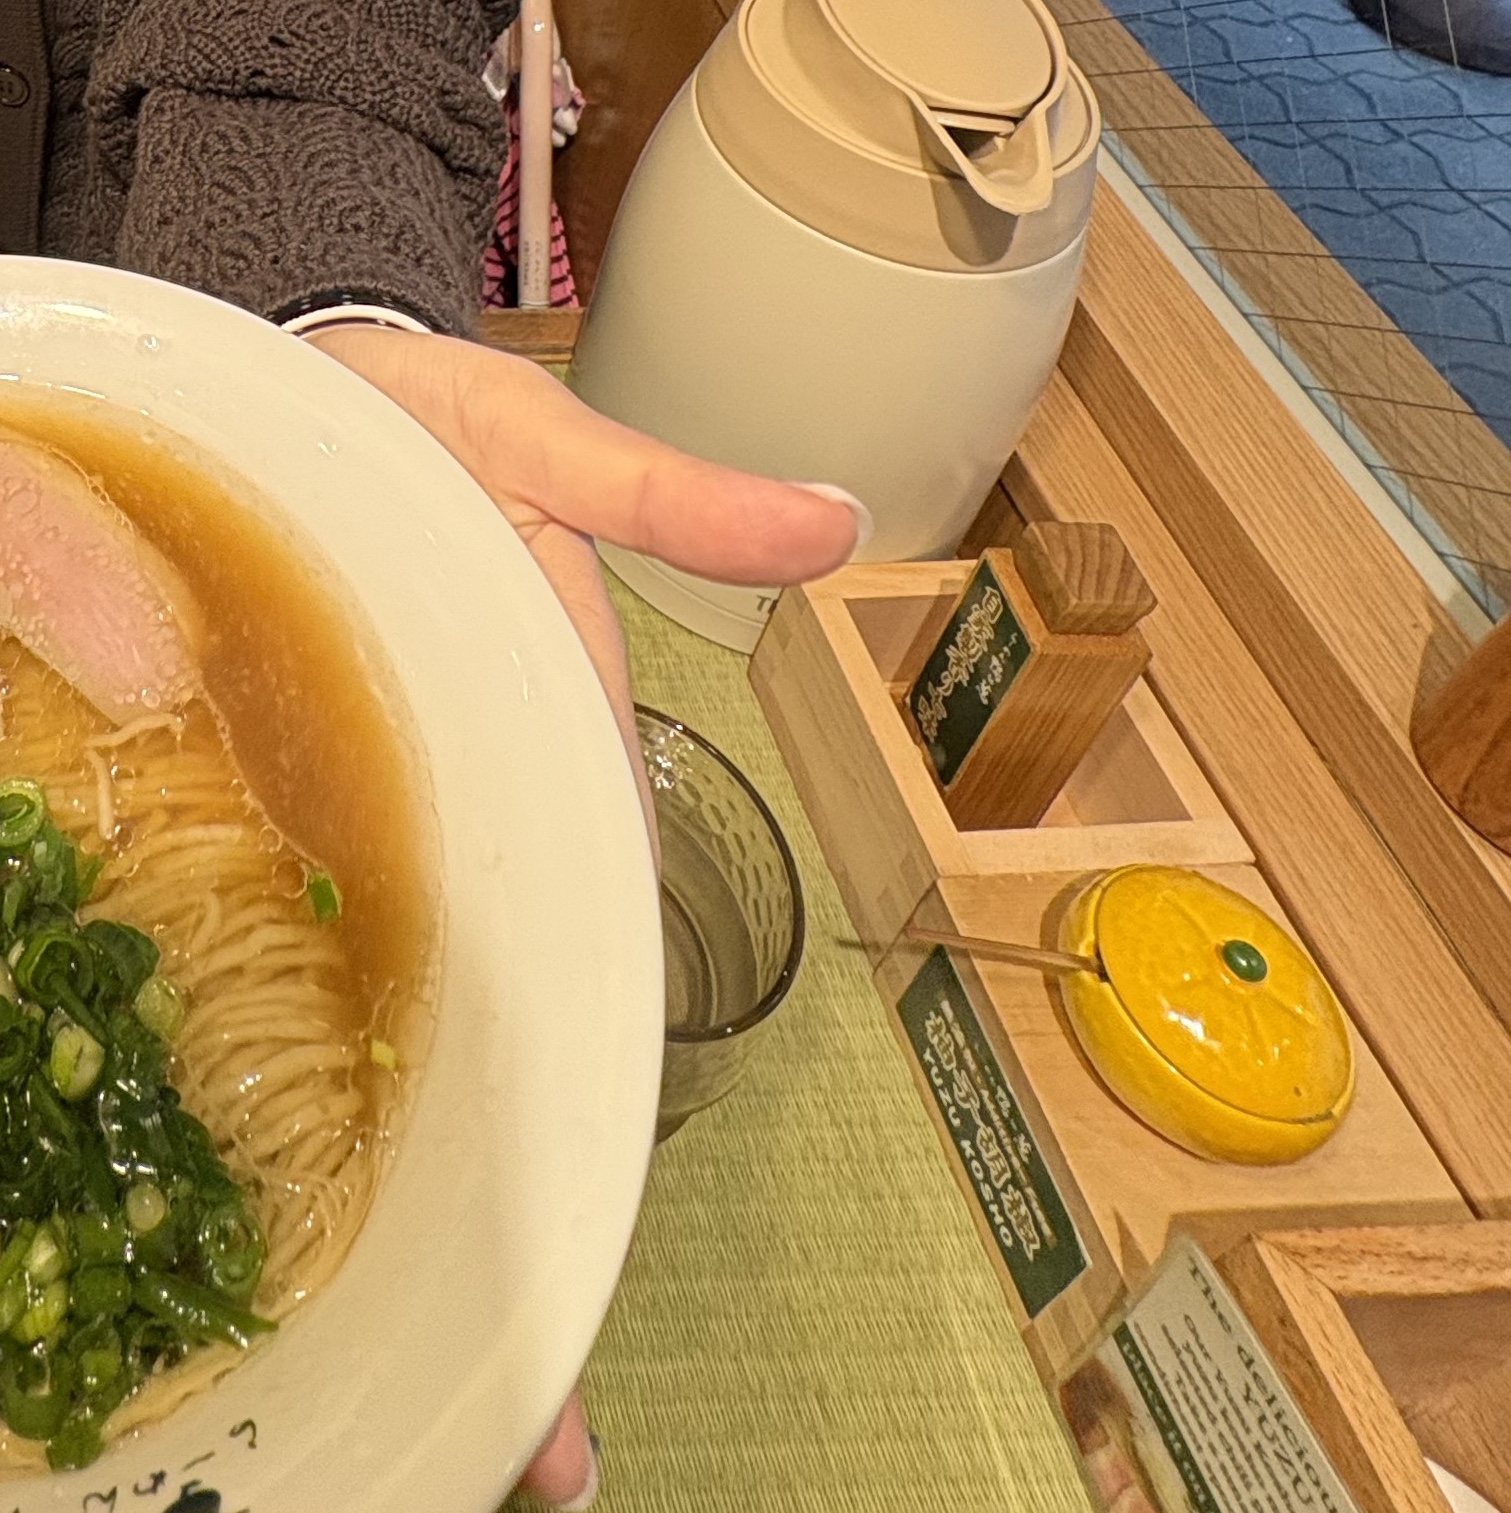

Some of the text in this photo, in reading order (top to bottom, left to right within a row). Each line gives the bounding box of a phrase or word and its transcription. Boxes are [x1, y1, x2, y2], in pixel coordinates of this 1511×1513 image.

[923, 1047, 961, 1128] YUZU
[960, 1138, 1013, 1248] KOSHO
[924, 1010, 1041, 1262] 柚子胡椒
[1189, 1257, 1232, 1334] The
[1183, 1313, 1212, 1362] Our
[1215, 1367, 1251, 1435] Yuzu
[1243, 1381, 1314, 1506] YUZU
